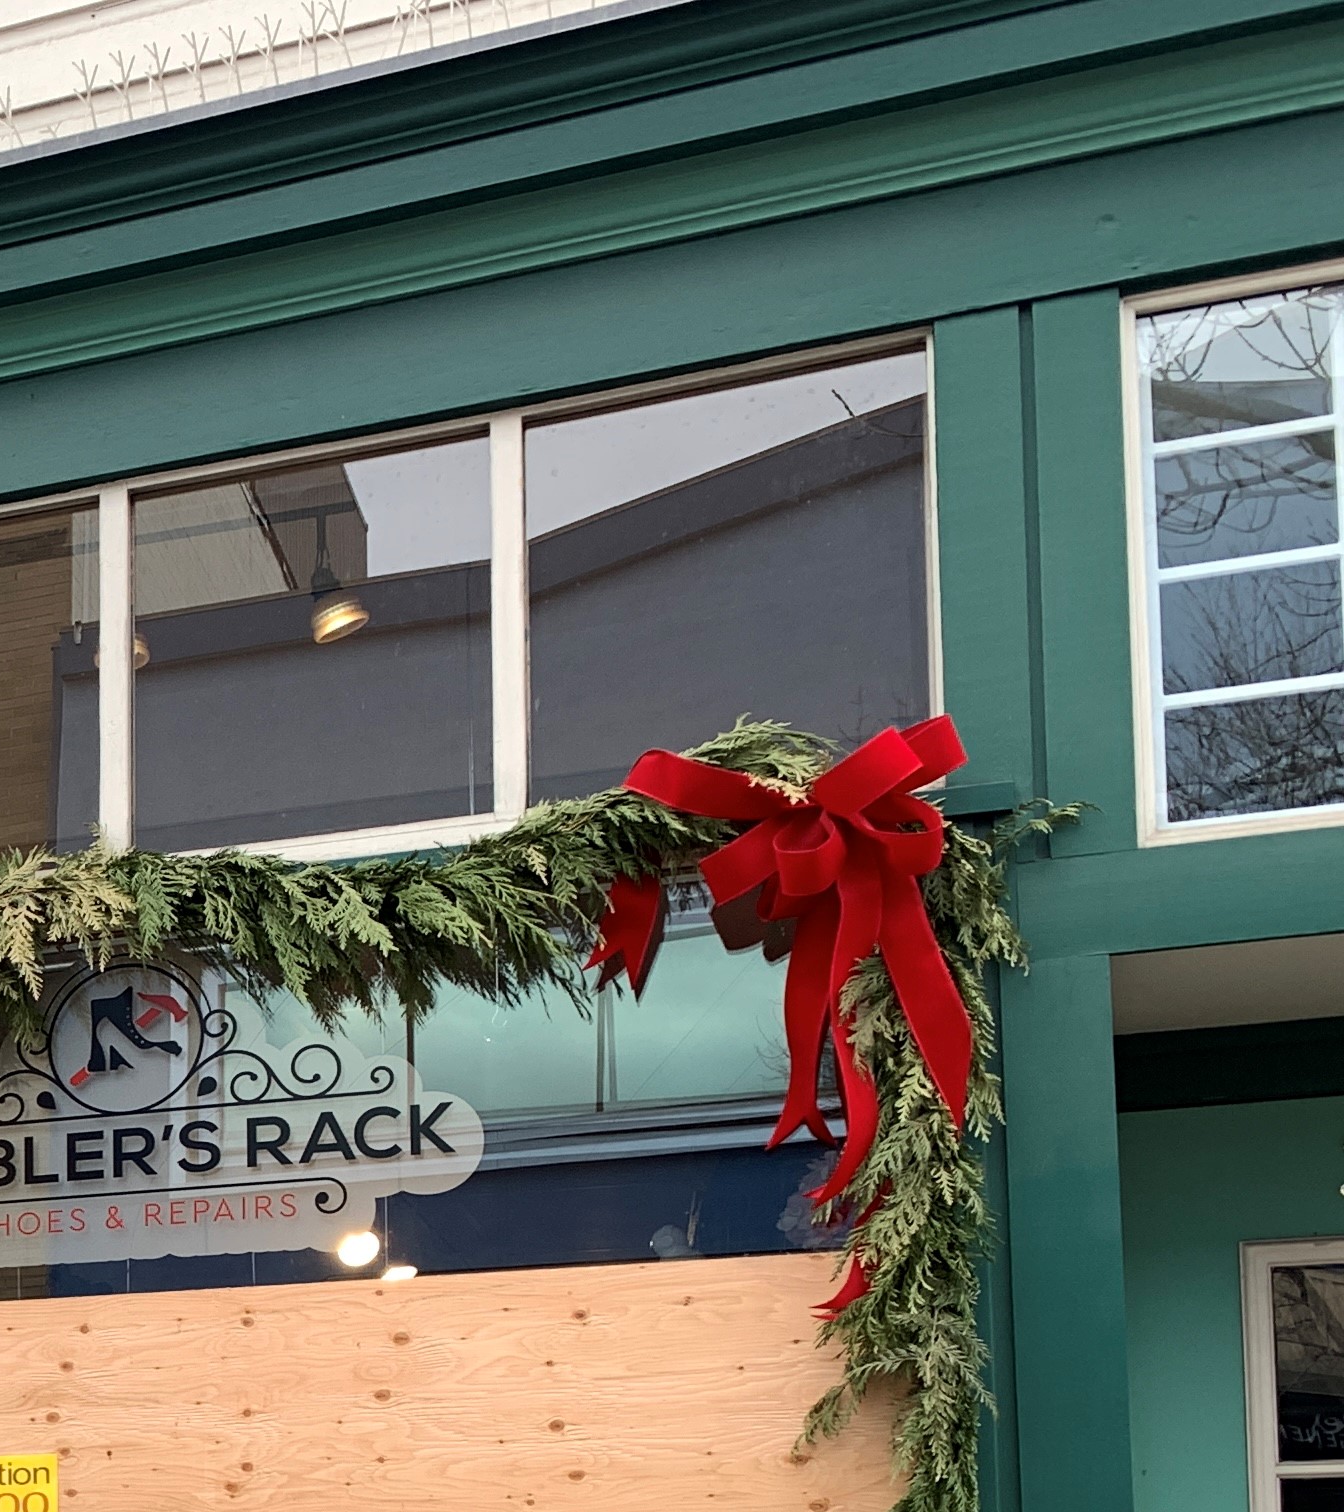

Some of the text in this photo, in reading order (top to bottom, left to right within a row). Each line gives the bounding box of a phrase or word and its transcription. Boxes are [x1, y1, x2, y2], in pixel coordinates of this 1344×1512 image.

[246, 1101, 457, 1168] RACK
[103, 1205, 124, 1231] &
[142, 1193, 299, 1228] REPAIRS
